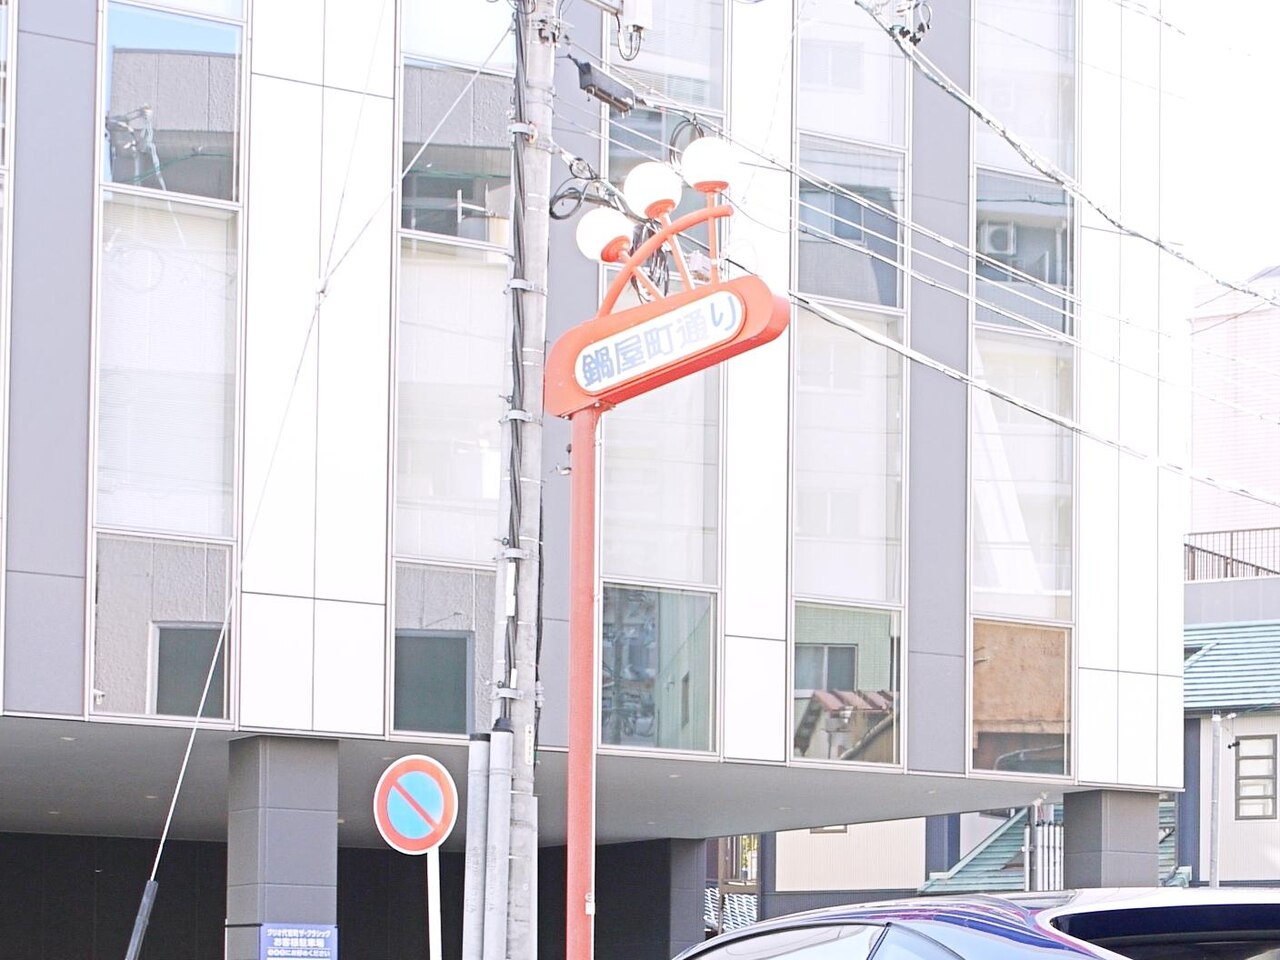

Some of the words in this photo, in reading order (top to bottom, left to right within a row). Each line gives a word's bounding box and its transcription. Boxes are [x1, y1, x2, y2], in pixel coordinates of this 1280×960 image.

[582, 295, 738, 388] 鍋屋町通り
